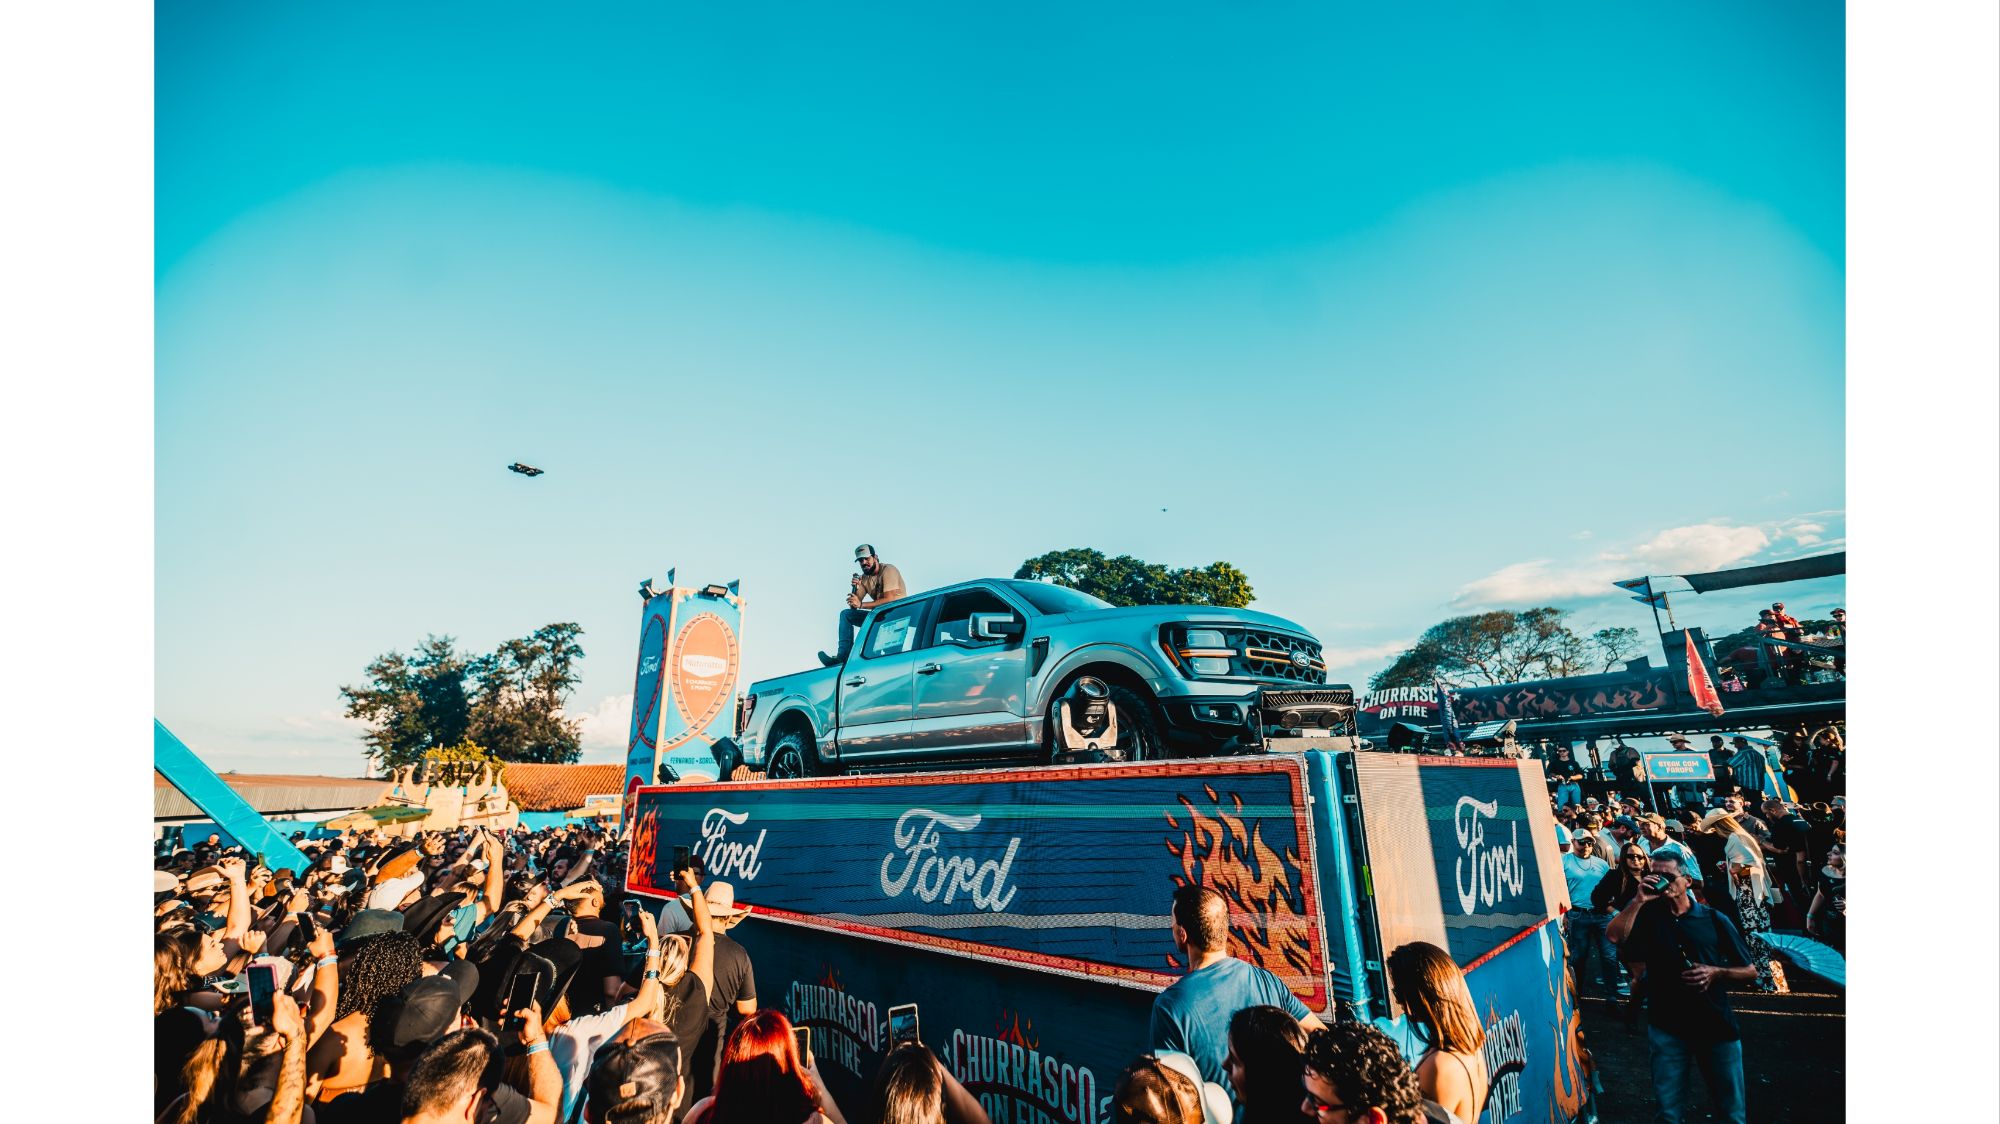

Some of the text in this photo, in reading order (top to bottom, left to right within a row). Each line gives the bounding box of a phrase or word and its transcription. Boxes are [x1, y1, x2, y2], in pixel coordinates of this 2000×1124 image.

[640, 655, 660, 675] Ford
[1359, 686, 1438, 711] CHURRASC
[1380, 705, 1428, 719] ON FIRE
[692, 808, 767, 881] Ford
[880, 808, 1021, 912] Ford
[1455, 796, 1523, 915] Ford
[791, 980, 879, 1053] CHURRASCO
[831, 1028, 863, 1079] FIRE
[952, 1028, 1096, 1124] CHURRASCO
[1501, 1071, 1522, 1120] FIRE
